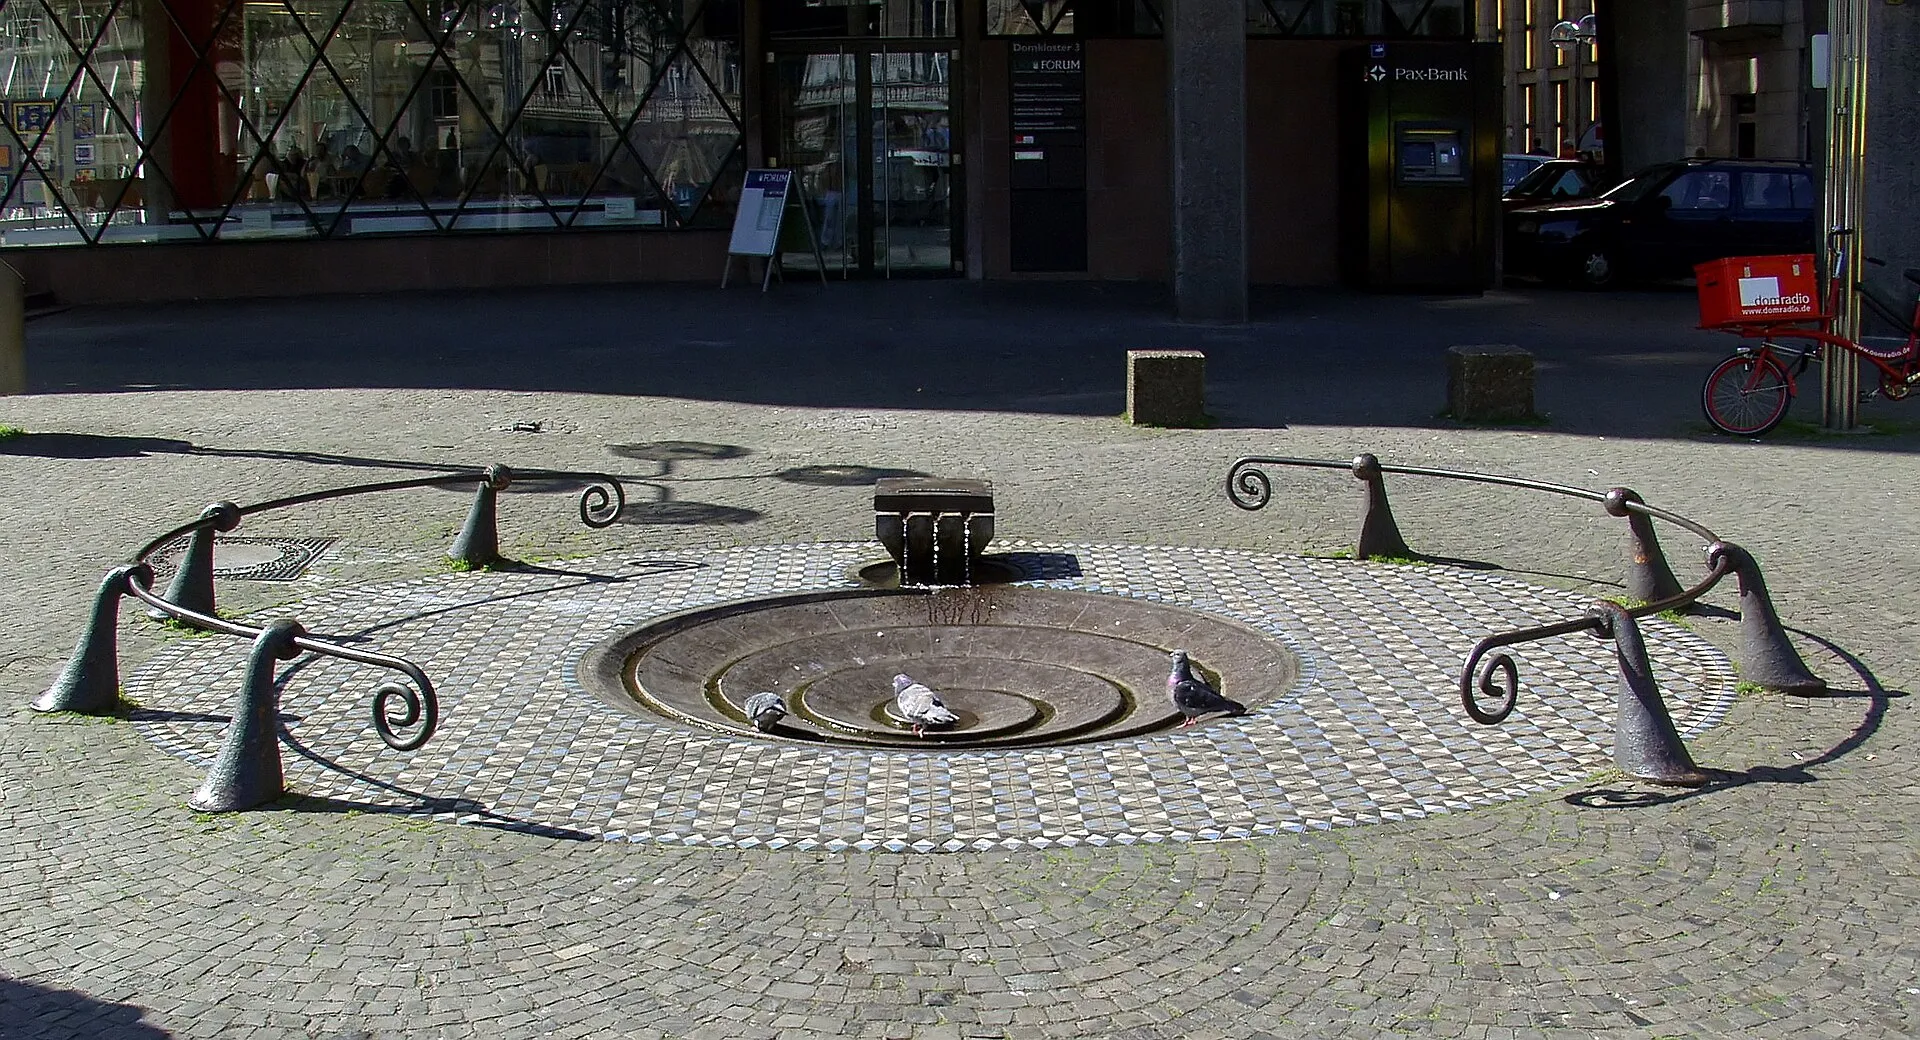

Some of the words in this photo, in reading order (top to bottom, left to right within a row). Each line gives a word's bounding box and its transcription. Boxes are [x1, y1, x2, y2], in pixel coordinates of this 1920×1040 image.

[1013, 43, 1072, 52] Domkloster
[1041, 60, 1080, 70] FORUM
[1395, 67, 1468, 81] Pax-Bank
[1754, 293, 1810, 306] domradio
[1742, 305, 1811, 315] www.domradio.de
